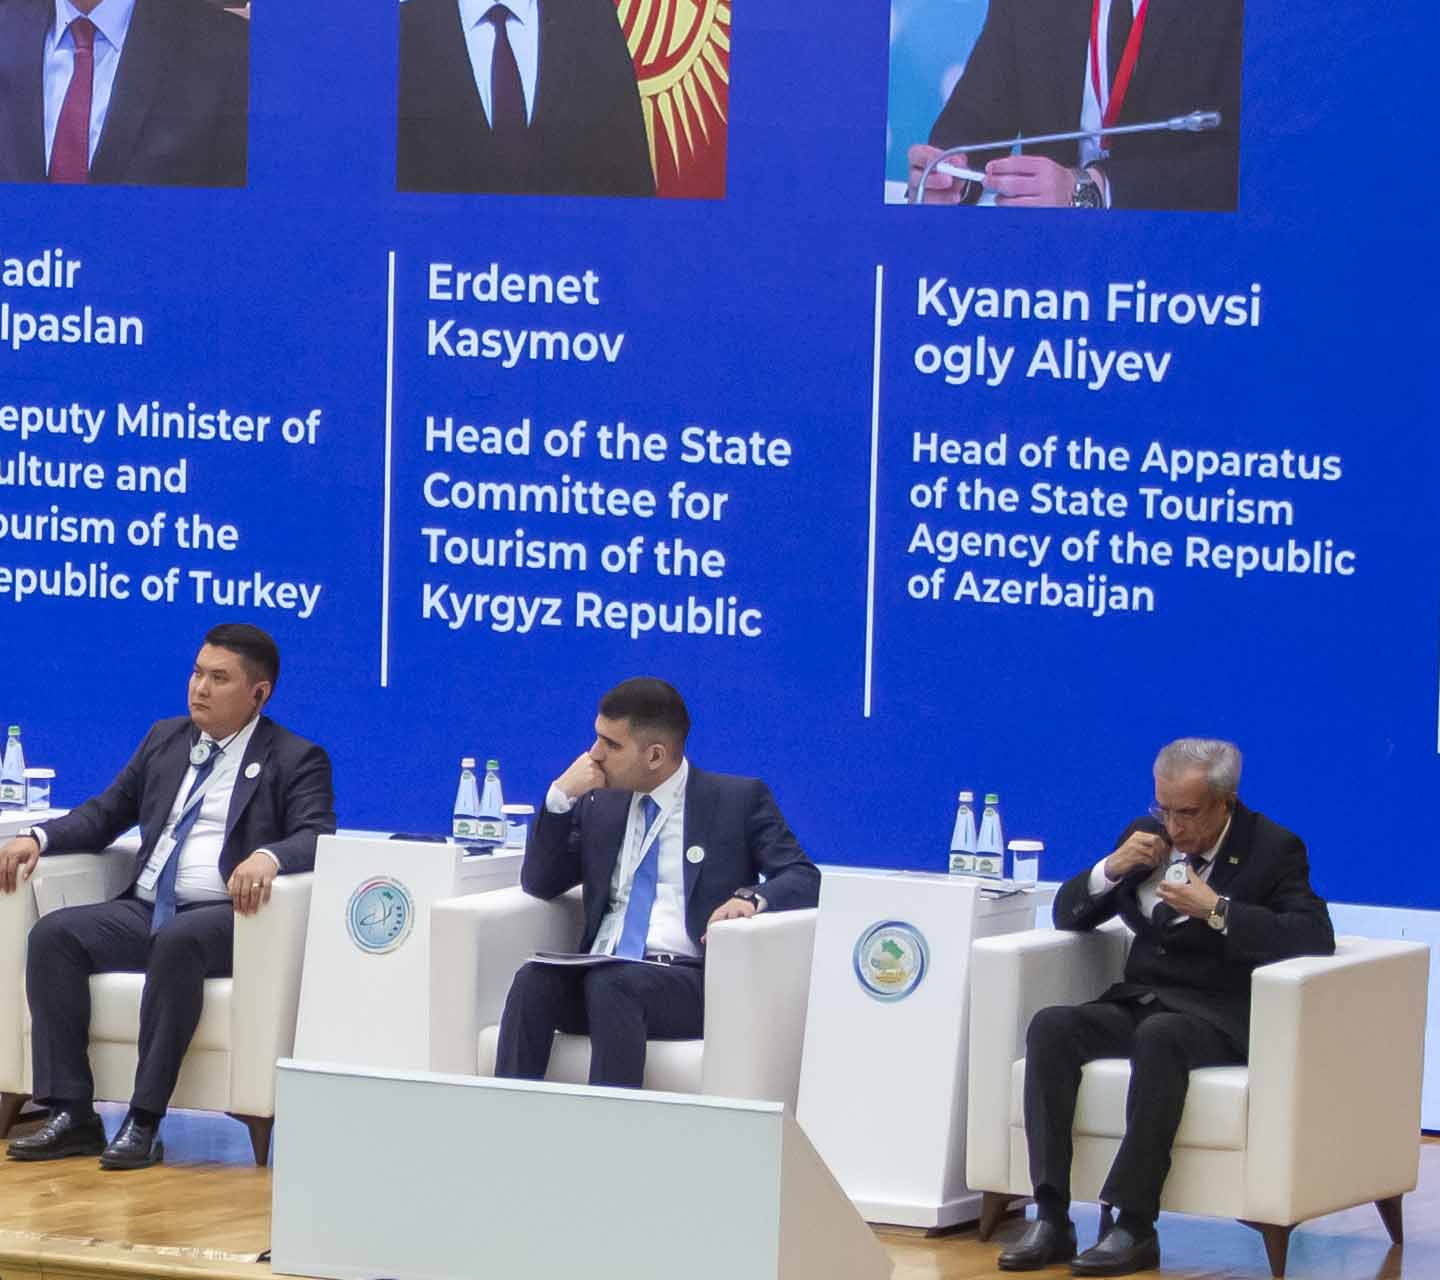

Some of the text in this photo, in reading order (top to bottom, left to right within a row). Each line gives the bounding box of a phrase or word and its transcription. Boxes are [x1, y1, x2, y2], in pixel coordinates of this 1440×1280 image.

[429, 262, 600, 305] Erdenet
[917, 277, 1261, 327] Kyanan Firovsi
[428, 319, 625, 369] Kasymov
[914, 335, 1172, 391] ogly Aliyev
[117, 400, 271, 442] Minister
[281, 408, 322, 445] of
[425, 415, 792, 467] Head of the State
[116, 458, 187, 494] and
[912, 431, 1342, 483] Head of the Apparatus
[423, 471, 729, 521] Committee for
[910, 476, 1293, 526] of the State Tourism
[127, 511, 167, 547] of
[174, 513, 239, 551] the
[421, 527, 726, 578] Tourism of the
[907, 522, 1356, 578] Agency of the Republic
[141, 567, 181, 602] of
[188, 570, 322, 619] Turkey
[422, 583, 762, 640] Kyrgyz Republic
[907, 567, 1154, 617] of Azerbaijan
